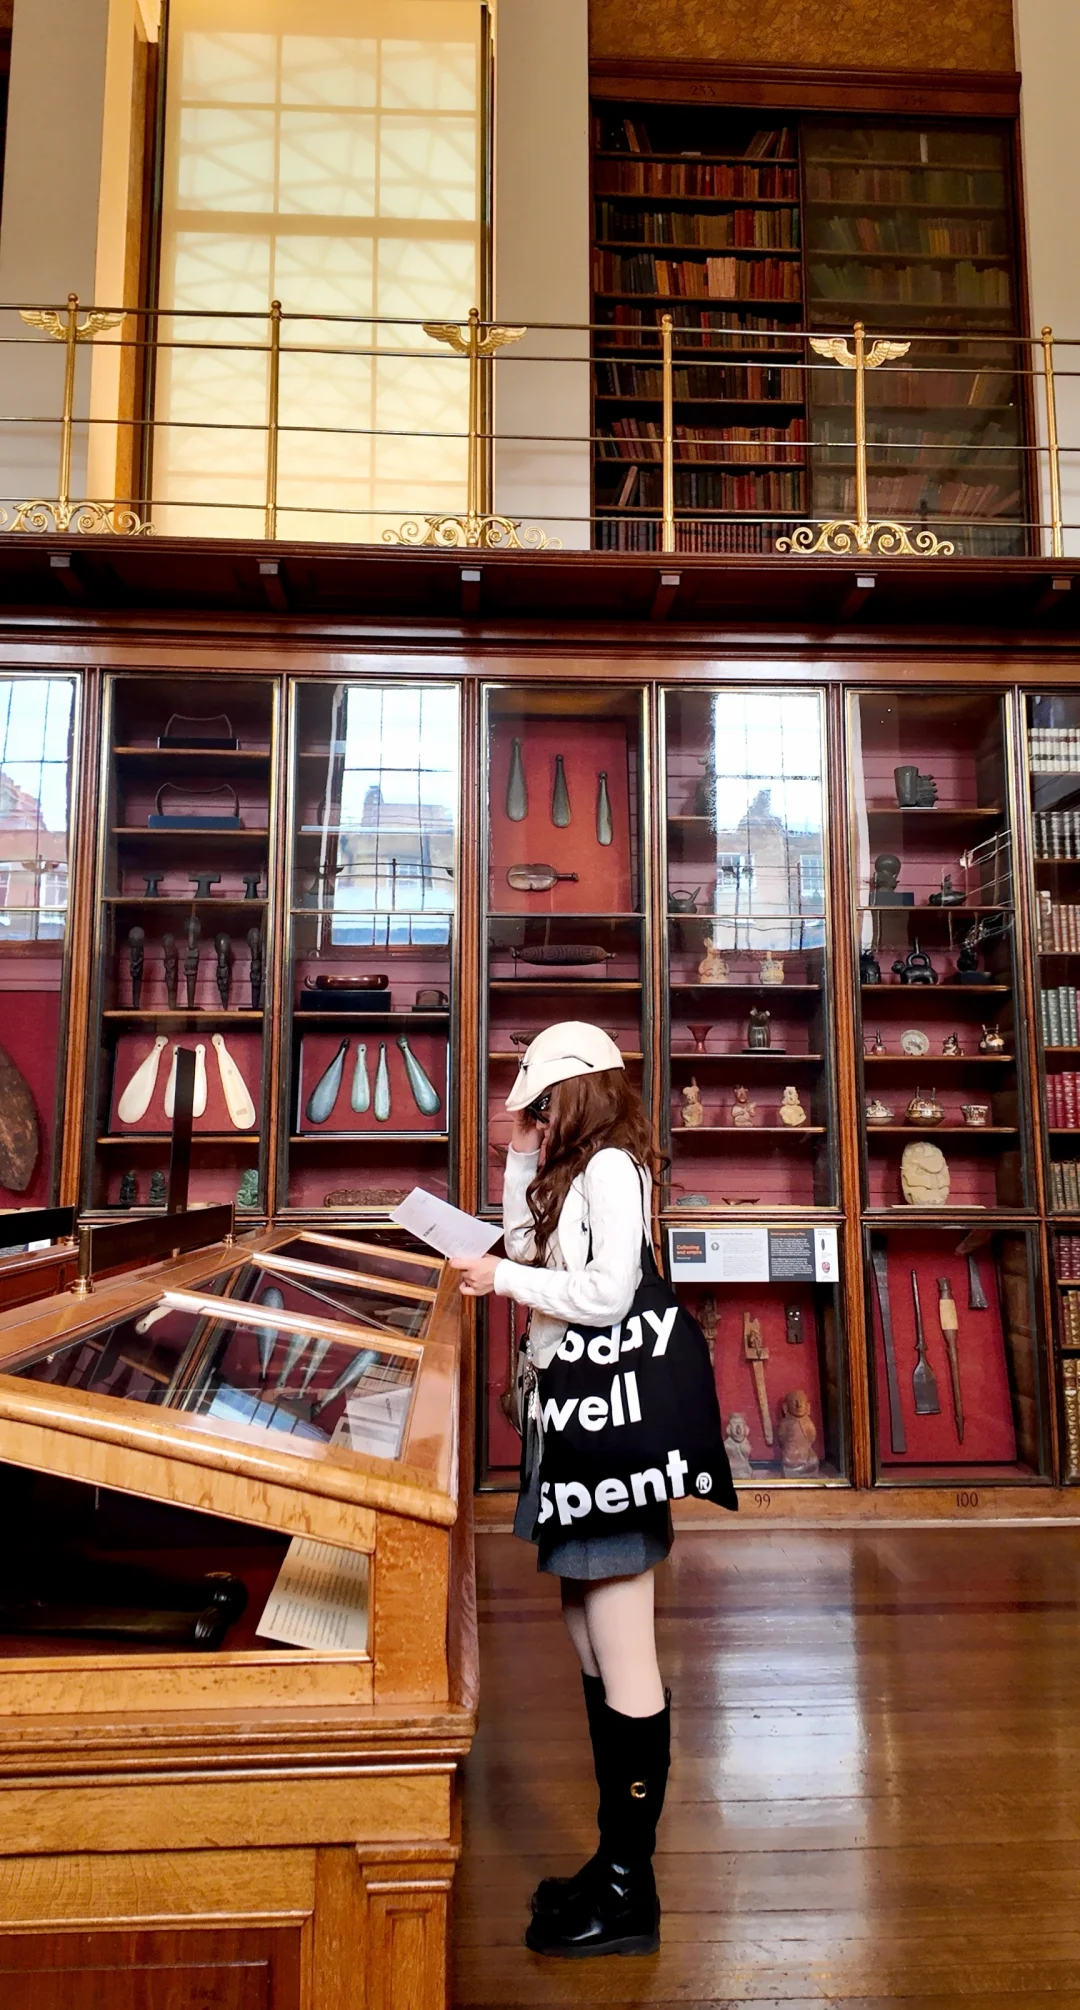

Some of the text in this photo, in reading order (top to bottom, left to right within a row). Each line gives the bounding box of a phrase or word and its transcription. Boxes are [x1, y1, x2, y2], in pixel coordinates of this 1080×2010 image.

[556, 1306, 678, 1365] oday
[542, 1371, 642, 1433] well
[754, 1493, 771, 1509] 99
[956, 1491, 979, 1508] 100
